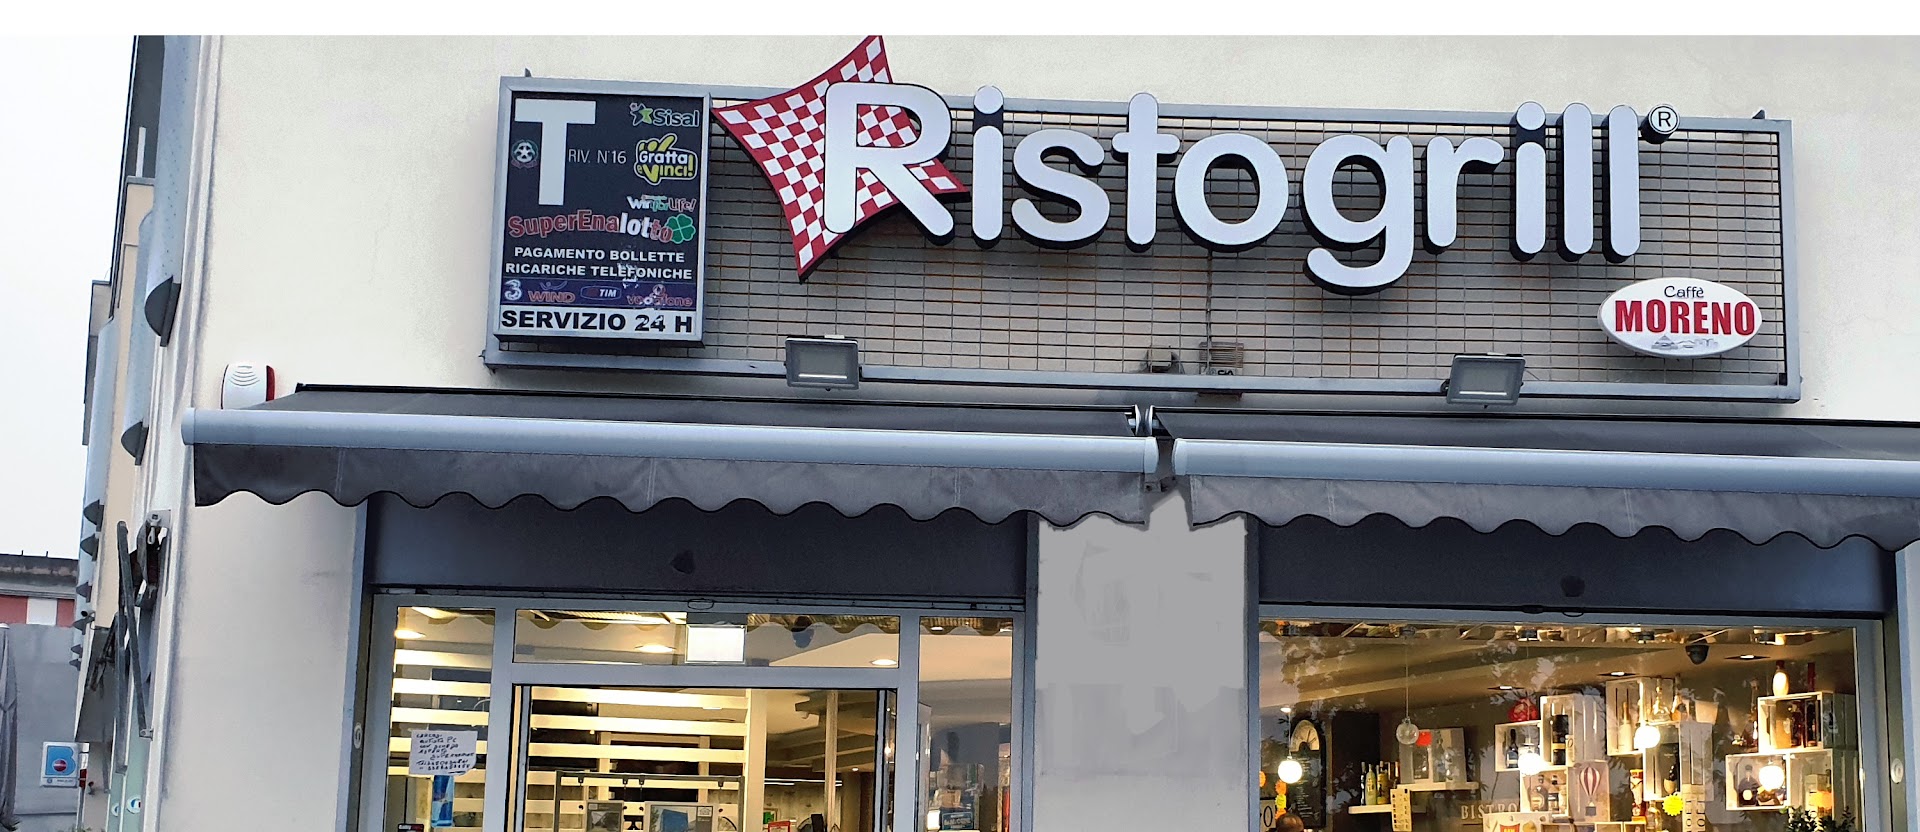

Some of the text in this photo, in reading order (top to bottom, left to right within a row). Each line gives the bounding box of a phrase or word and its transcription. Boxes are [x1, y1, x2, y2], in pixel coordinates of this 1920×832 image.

[653, 109, 700, 127] Sisal
[514, 98, 597, 206] T
[568, 149, 591, 164] RIV.
[638, 150, 688, 165] Gratta
[824, 81, 1641, 293] Ristogrill
[514, 247, 685, 263] PAGAMENTO BOLLETTE
[505, 263, 692, 279] RICARICHE TELEFONICHE
[527, 290, 576, 304] WIND
[599, 288, 617, 297] TIM
[501, 310, 692, 333] SERVIZIO 24 H
[1615, 299, 1755, 336] MORENO
